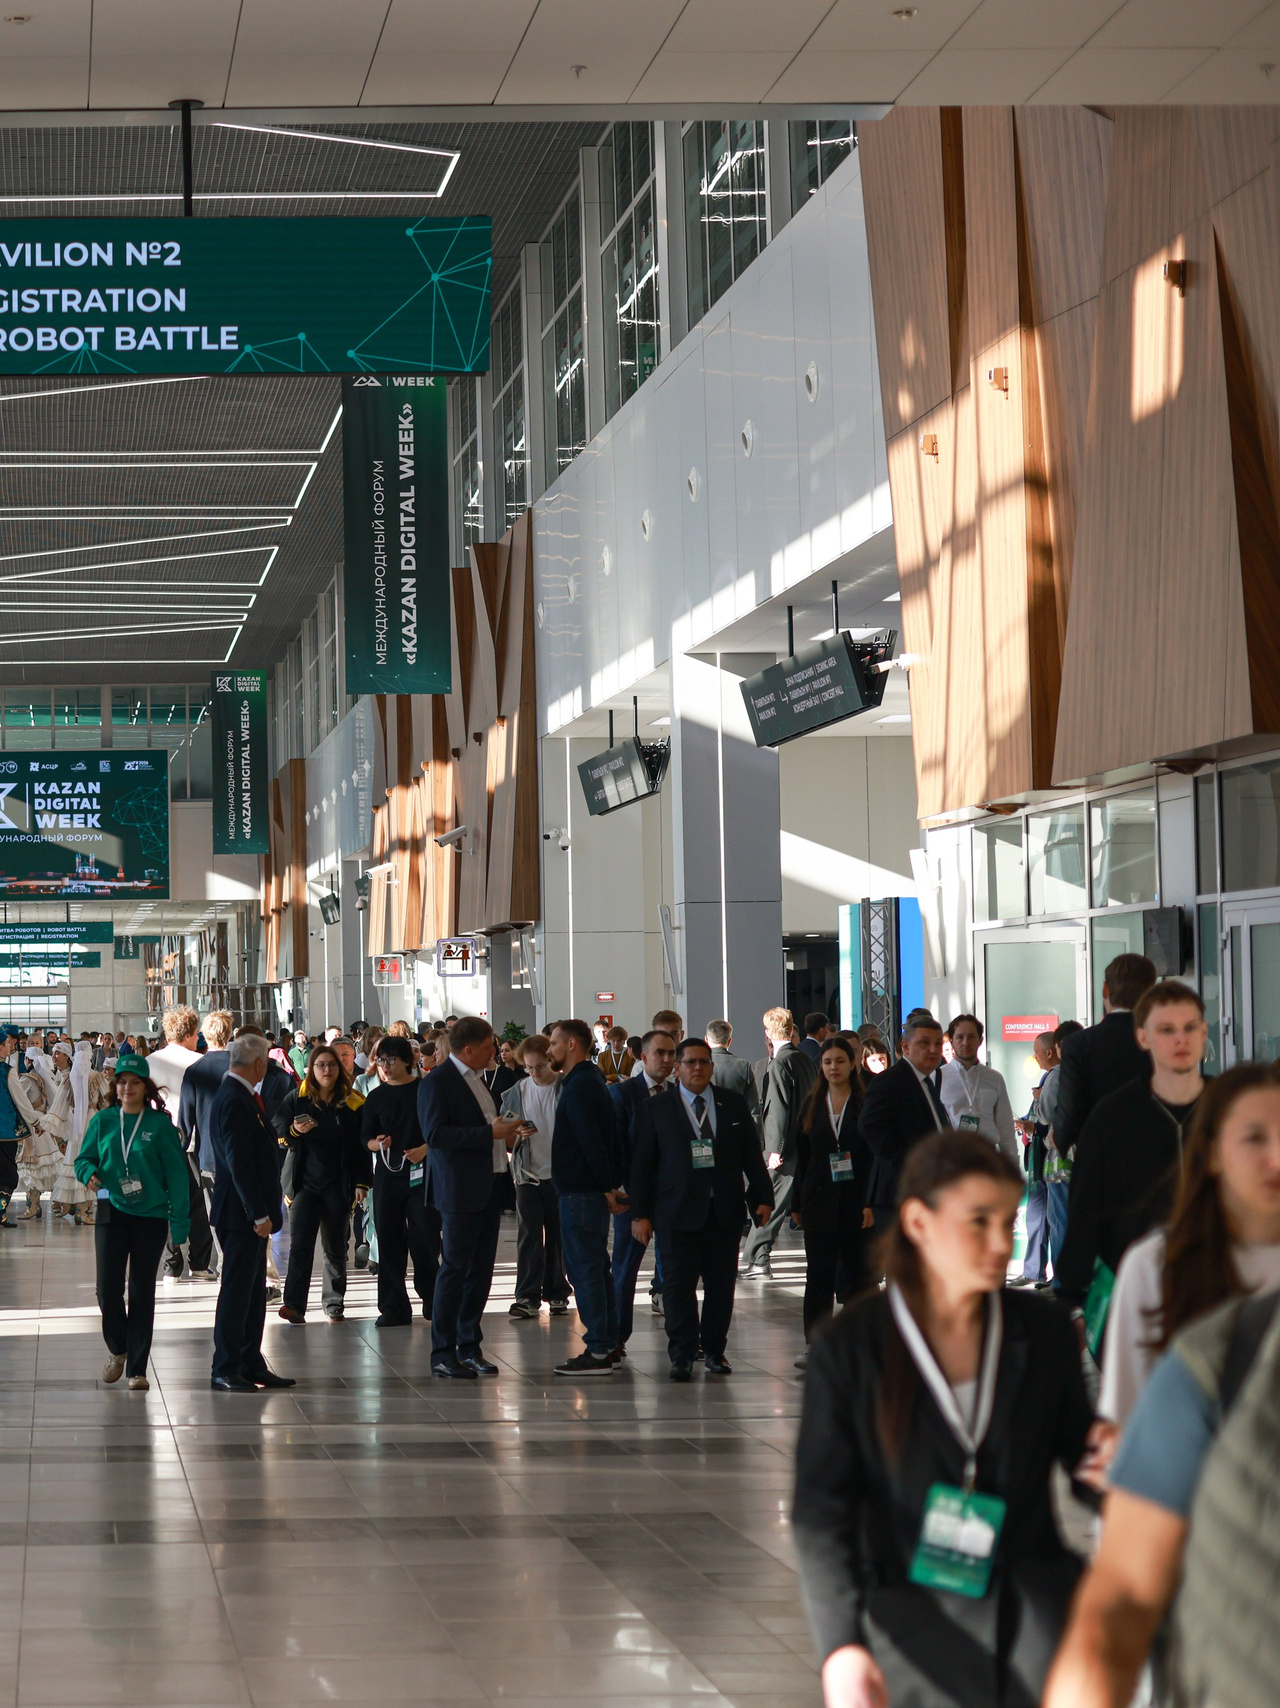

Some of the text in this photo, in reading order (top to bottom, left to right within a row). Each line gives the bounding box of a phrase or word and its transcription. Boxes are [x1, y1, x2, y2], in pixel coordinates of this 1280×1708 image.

[126, 241, 181, 266] №2
[115, 326, 238, 350] BATTLE
[392, 376, 435, 387] WEEK
[398, 402, 417, 666] «KAZAN DIGITAL WEEK»
[371, 459, 388, 665] МЕЖДУНАРОДНЫЙ ФОРУМ
[242, 744, 250, 790] DIGITAL
[34, 782, 101, 794] KAZAN
[34, 798, 100, 810] DIGITAL
[226, 762, 236, 840] МЕЖДУНАРОДНЫЙ
[35, 814, 102, 828] WEEK
[66, 834, 103, 842] ФОРУМ
